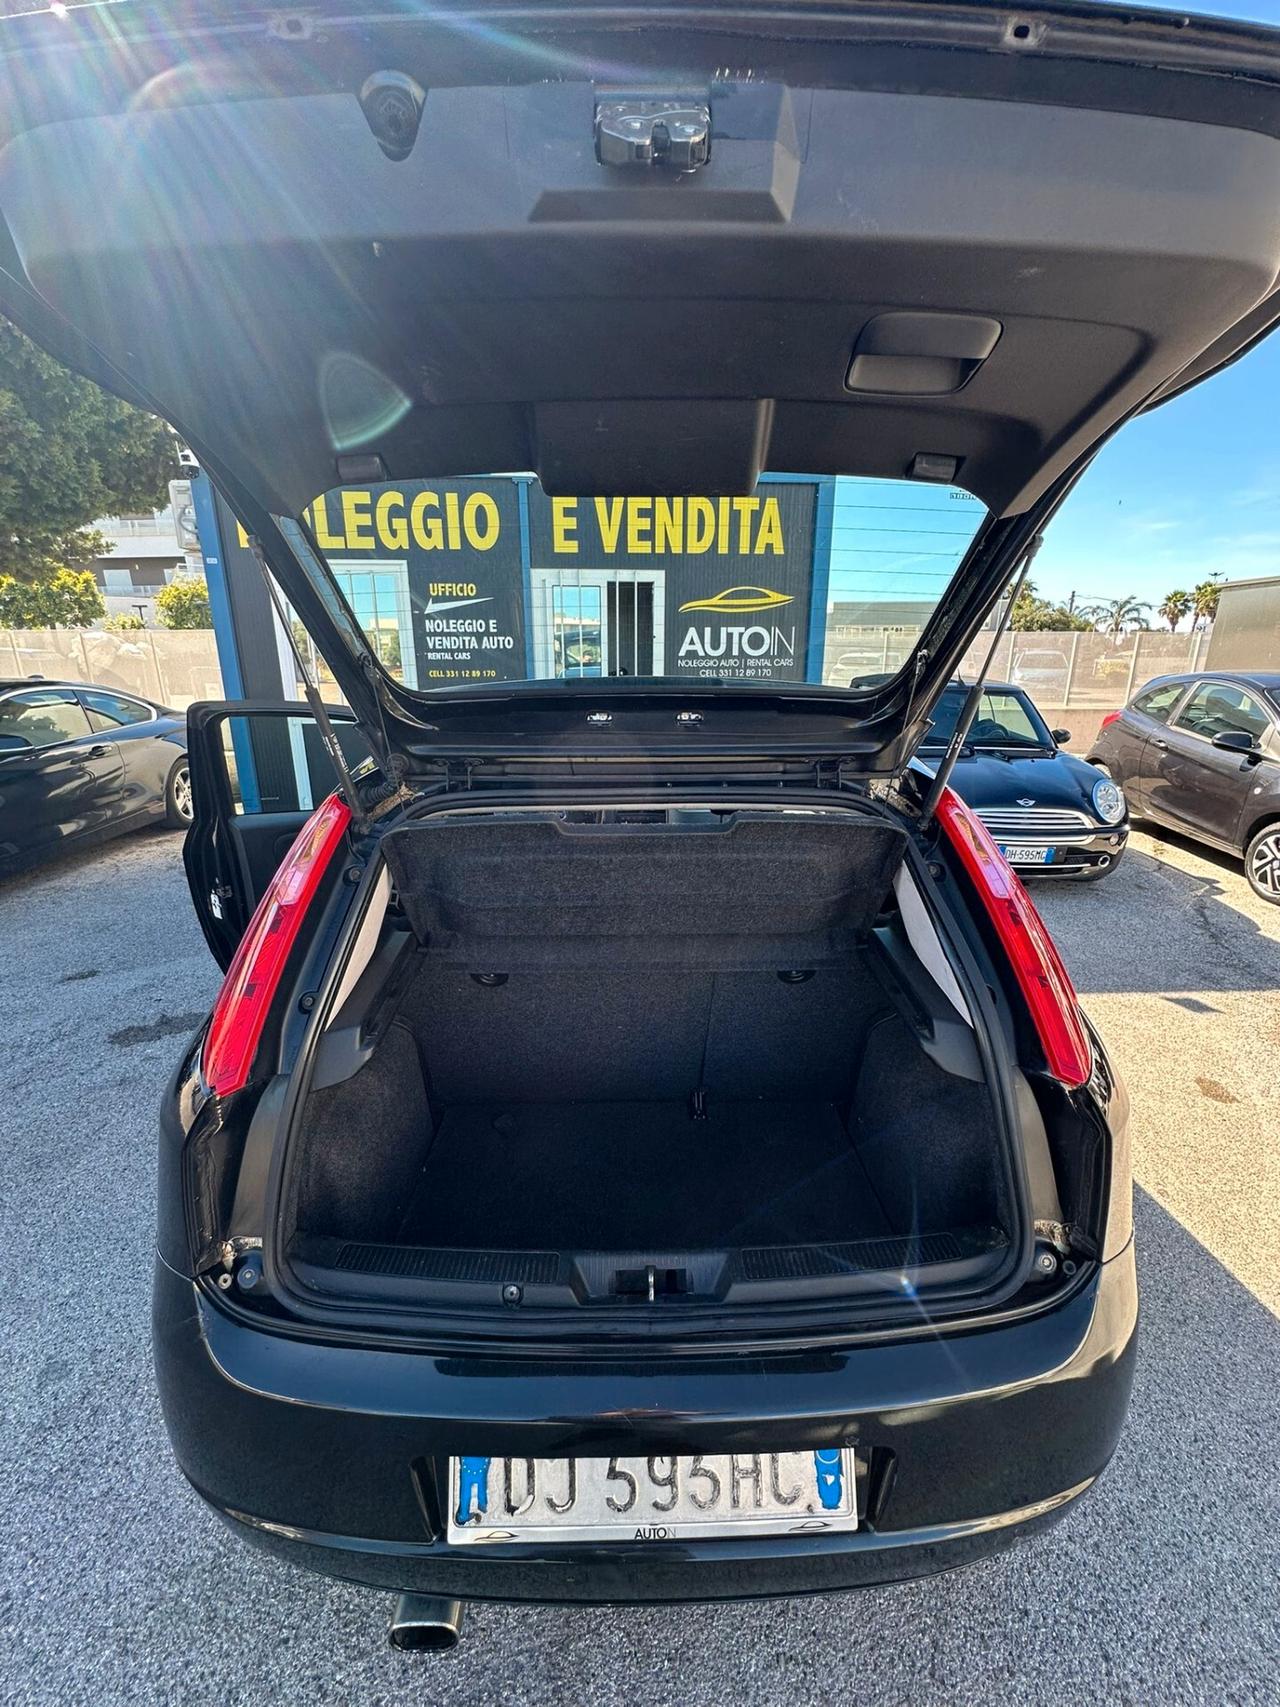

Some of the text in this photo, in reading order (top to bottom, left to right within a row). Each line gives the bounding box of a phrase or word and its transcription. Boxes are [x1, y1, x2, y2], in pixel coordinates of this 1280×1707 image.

[236, 490, 785, 555] LEGGIO E VENDITA
[429, 583, 477, 597] UFFICIO
[425, 619, 498, 633] NOLEGGIO E
[426, 636, 514, 650] VENDITA AUTO
[678, 626, 796, 657] AUTOIN
[427, 652, 471, 660] RENTAL CARS
[677, 658, 794, 668] NOLEGGIO AUTO RENTAL CARS
[429, 670, 496, 678] CELL 331 12 89 170
[699, 668, 772, 678] CELL 331 12 89 170
